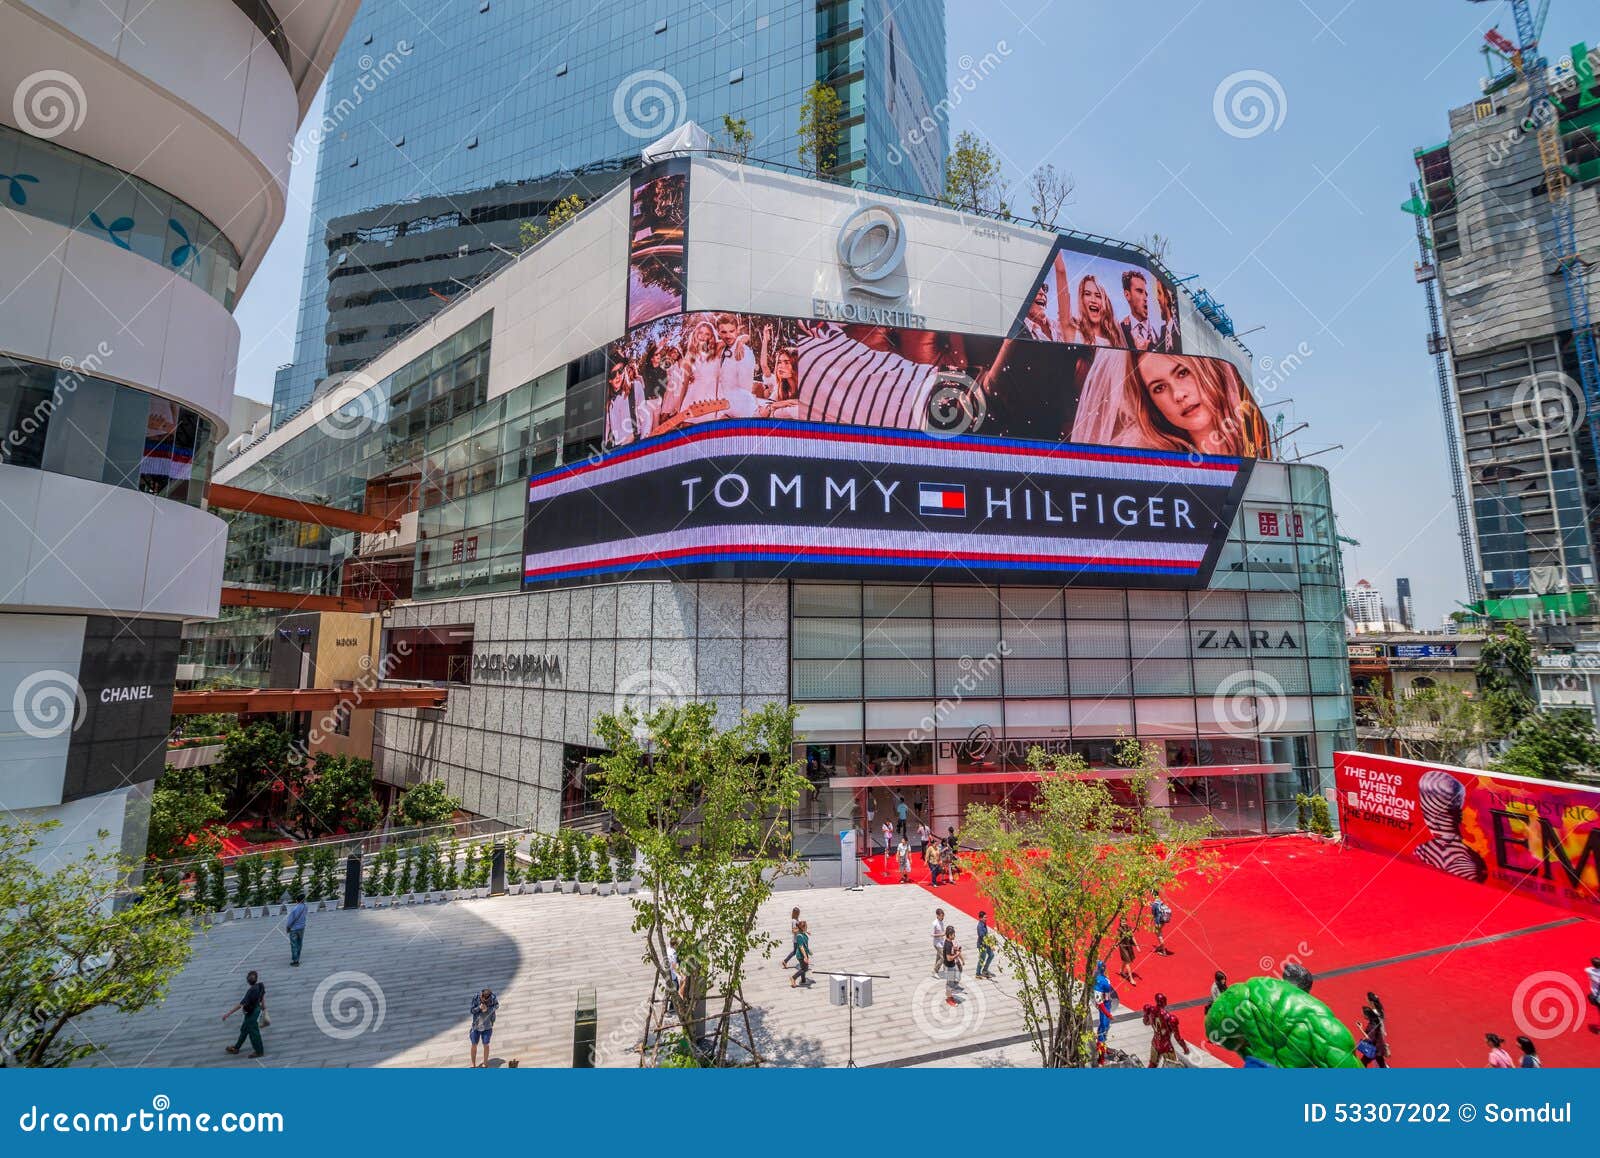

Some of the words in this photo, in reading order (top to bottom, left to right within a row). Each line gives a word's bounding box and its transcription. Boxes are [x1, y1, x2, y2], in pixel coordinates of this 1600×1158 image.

[681, 473, 900, 513] TOMMY
[986, 486, 1195, 529] HILFIGER
[1198, 629, 1301, 649] ZARA
[100, 685, 154, 703] CHANEL
[1344, 766, 1366, 779] THE
[1369, 770, 1402, 786] DAYS
[1359, 779, 1396, 796] WHEN
[1360, 790, 1415, 811] FASHION
[1363, 811, 1414, 831] DISTRICT
